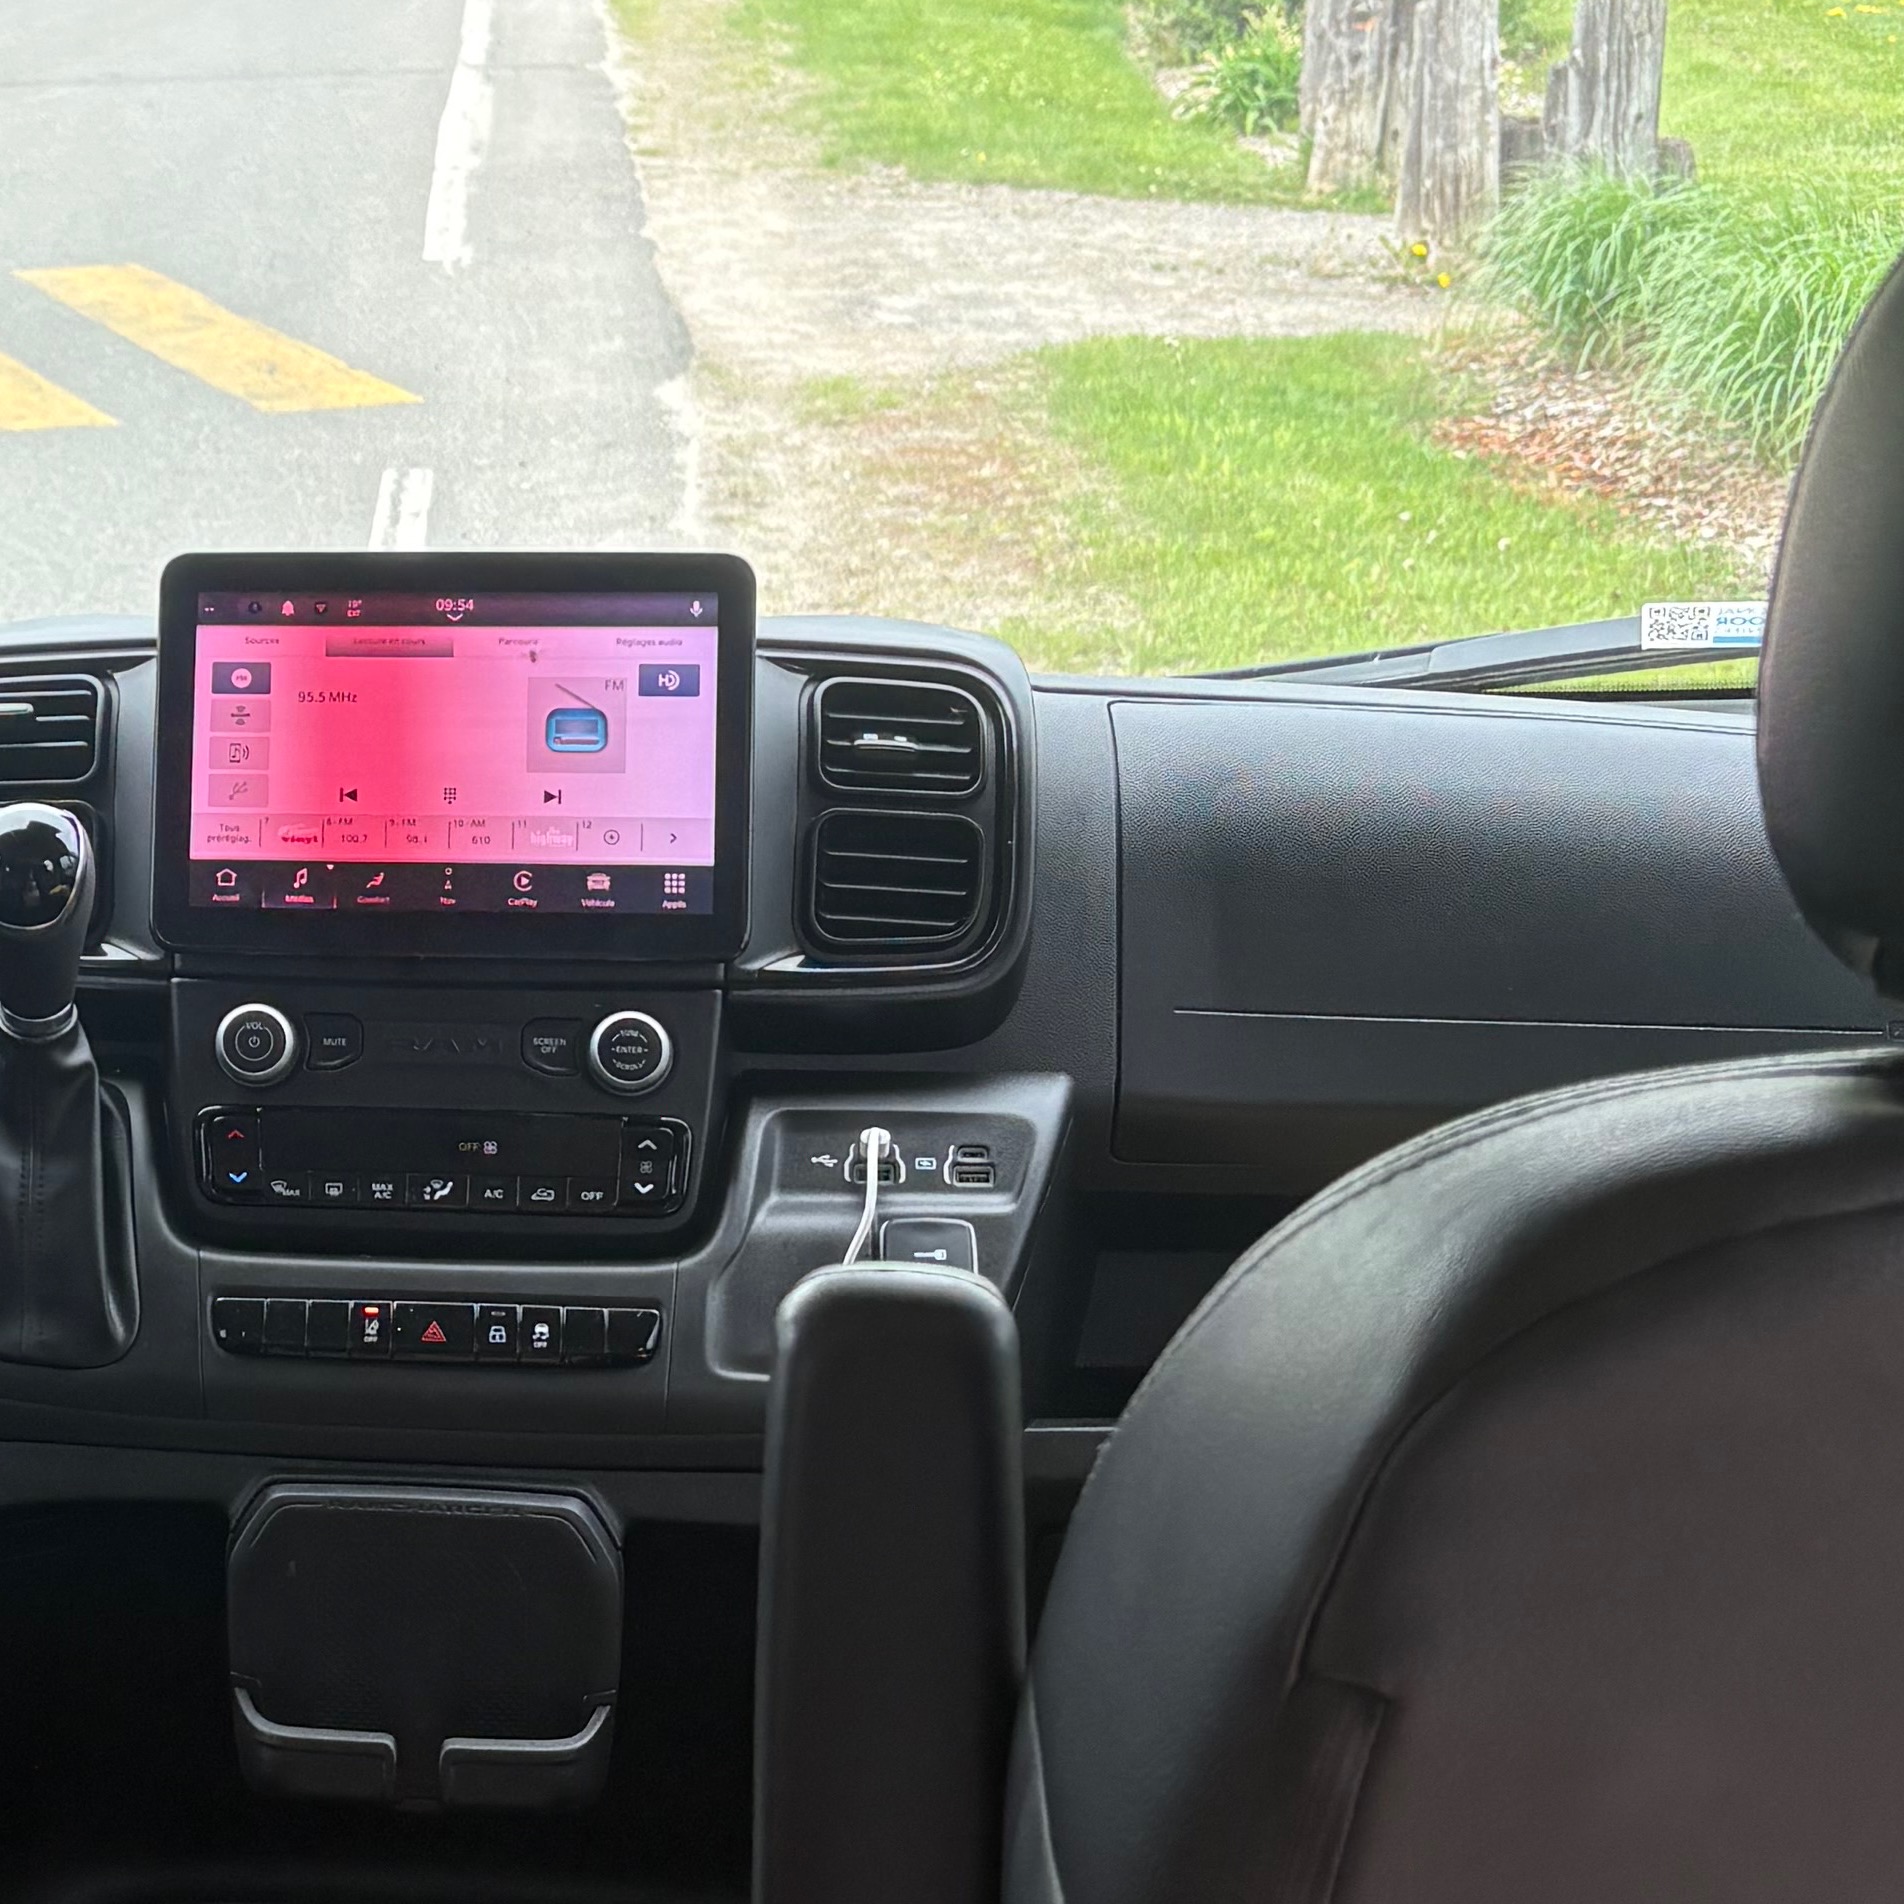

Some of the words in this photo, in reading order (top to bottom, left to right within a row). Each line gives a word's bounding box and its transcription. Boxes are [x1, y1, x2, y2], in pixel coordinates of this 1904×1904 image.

[435, 598, 474, 611] 09:54
[604, 679, 625, 691] FM
[298, 691, 326, 703] 95.5
[329, 691, 358, 703] MHz
[219, 823, 240, 833] Tous
[507, 897, 538, 908] CarPlay
[246, 1022, 264, 1031] VOL
[322, 1038, 347, 1046] MUTE
[533, 1037, 566, 1046] SCREEN
[541, 1046, 557, 1054] OFF
[615, 1046, 643, 1054] ENTER
[458, 1142, 480, 1152] OFF
[372, 1183, 394, 1191] MAX
[374, 1191, 392, 1200] A/C
[484, 1189, 504, 1199] A/C
[581, 1191, 604, 1201] OFF
